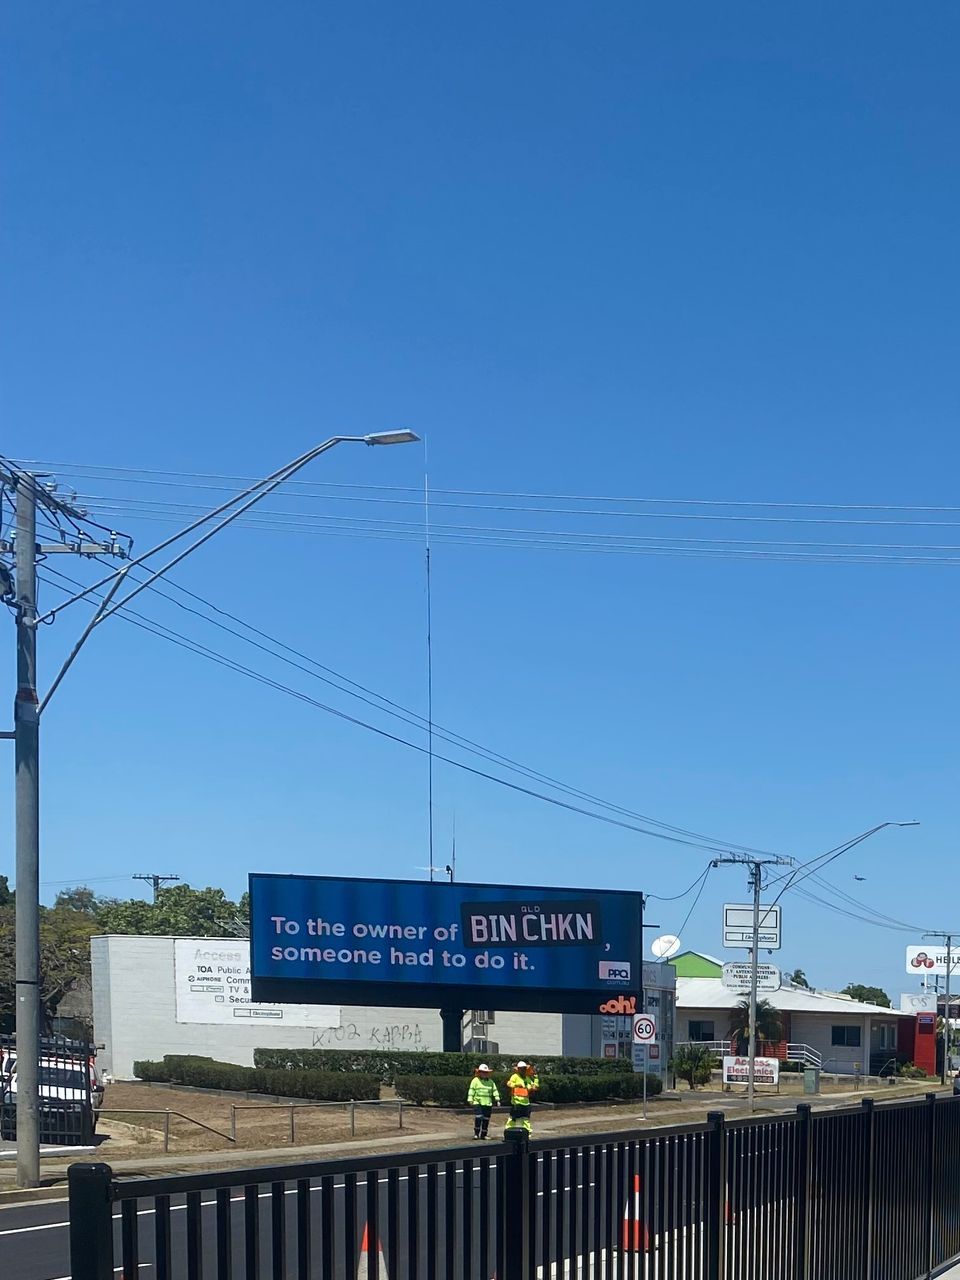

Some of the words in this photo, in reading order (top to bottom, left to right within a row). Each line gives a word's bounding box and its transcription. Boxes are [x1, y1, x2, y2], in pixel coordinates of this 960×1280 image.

[521, 905, 541, 913] QLD
[271, 916, 300, 935] To
[307, 918, 346, 937] the
[353, 924, 427, 940] owner
[433, 923, 459, 942] of
[470, 914, 517, 943] BIN
[522, 913, 594, 941] CHKN
[271, 946, 382, 965] someone
[390, 947, 433, 966] had
[442, 951, 467, 968] to
[474, 951, 505, 969] do
[513, 952, 536, 971] it.
[217, 966, 241, 974] Public
[608, 968, 629, 979] PPQ
[637, 1023, 652, 1034] 60
[735, 1058, 769, 1066] Acess
[727, 1066, 775, 1076] Electonics
